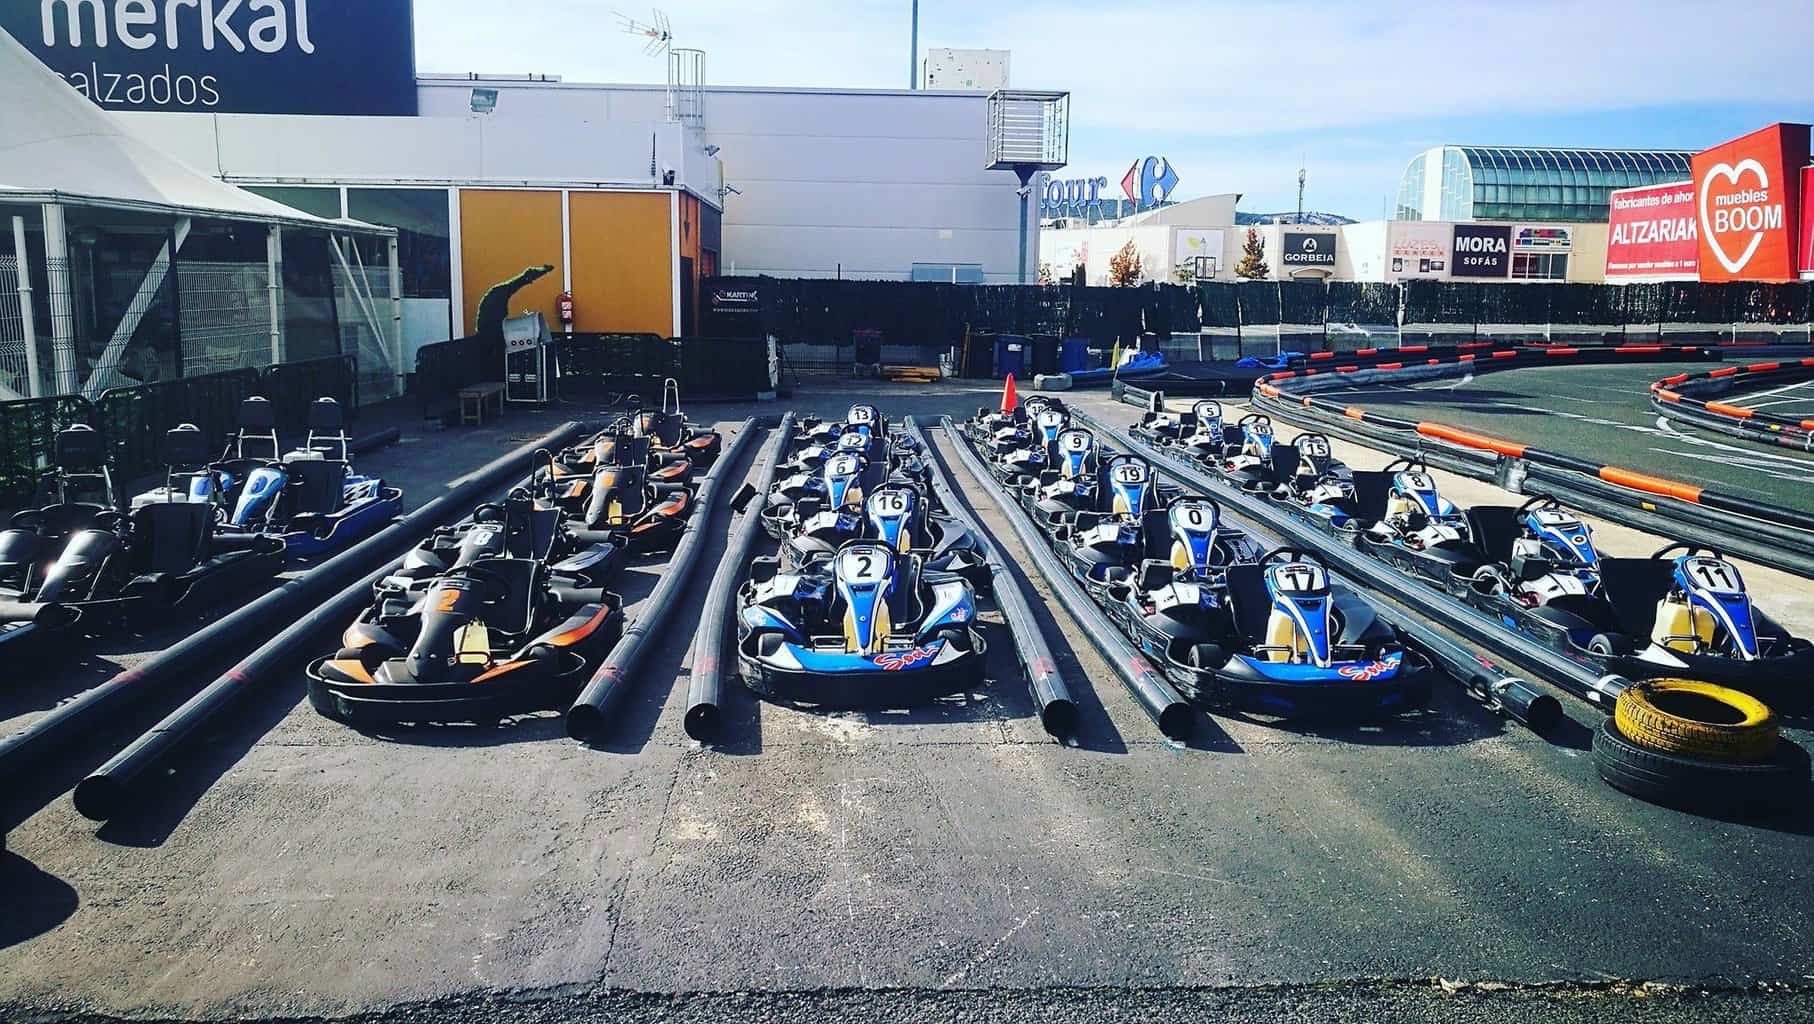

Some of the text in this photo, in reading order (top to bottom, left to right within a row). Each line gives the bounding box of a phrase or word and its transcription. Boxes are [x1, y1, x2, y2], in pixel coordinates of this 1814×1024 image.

[40, 0, 316, 54] merkal
[53, 61, 220, 106] alzados
[1661, 192, 1673, 205] de
[1715, 190, 1769, 207] muebles
[1714, 204, 1783, 233] BOOM
[1610, 216, 1697, 246] ALTZARIAK
[1455, 236, 1507, 253] MORA
[1284, 253, 1334, 262] GORBEIA
[1463, 255, 1498, 266] SOFÁS
[854, 409, 870, 421] 13
[1206, 407, 1215, 417] 5
[1072, 438, 1082, 449] 9
[1306, 443, 1327, 455] 15
[836, 461, 846, 474] 6
[1119, 469, 1140, 481] 19
[1411, 475, 1426, 488] 8
[878, 496, 904, 510] 16
[1188, 510, 1202, 525] 0
[856, 556, 873, 578] 2
[1285, 571, 1315, 591] 17
[1695, 566, 1734, 589] 11
[436, 589, 461, 612] 2
